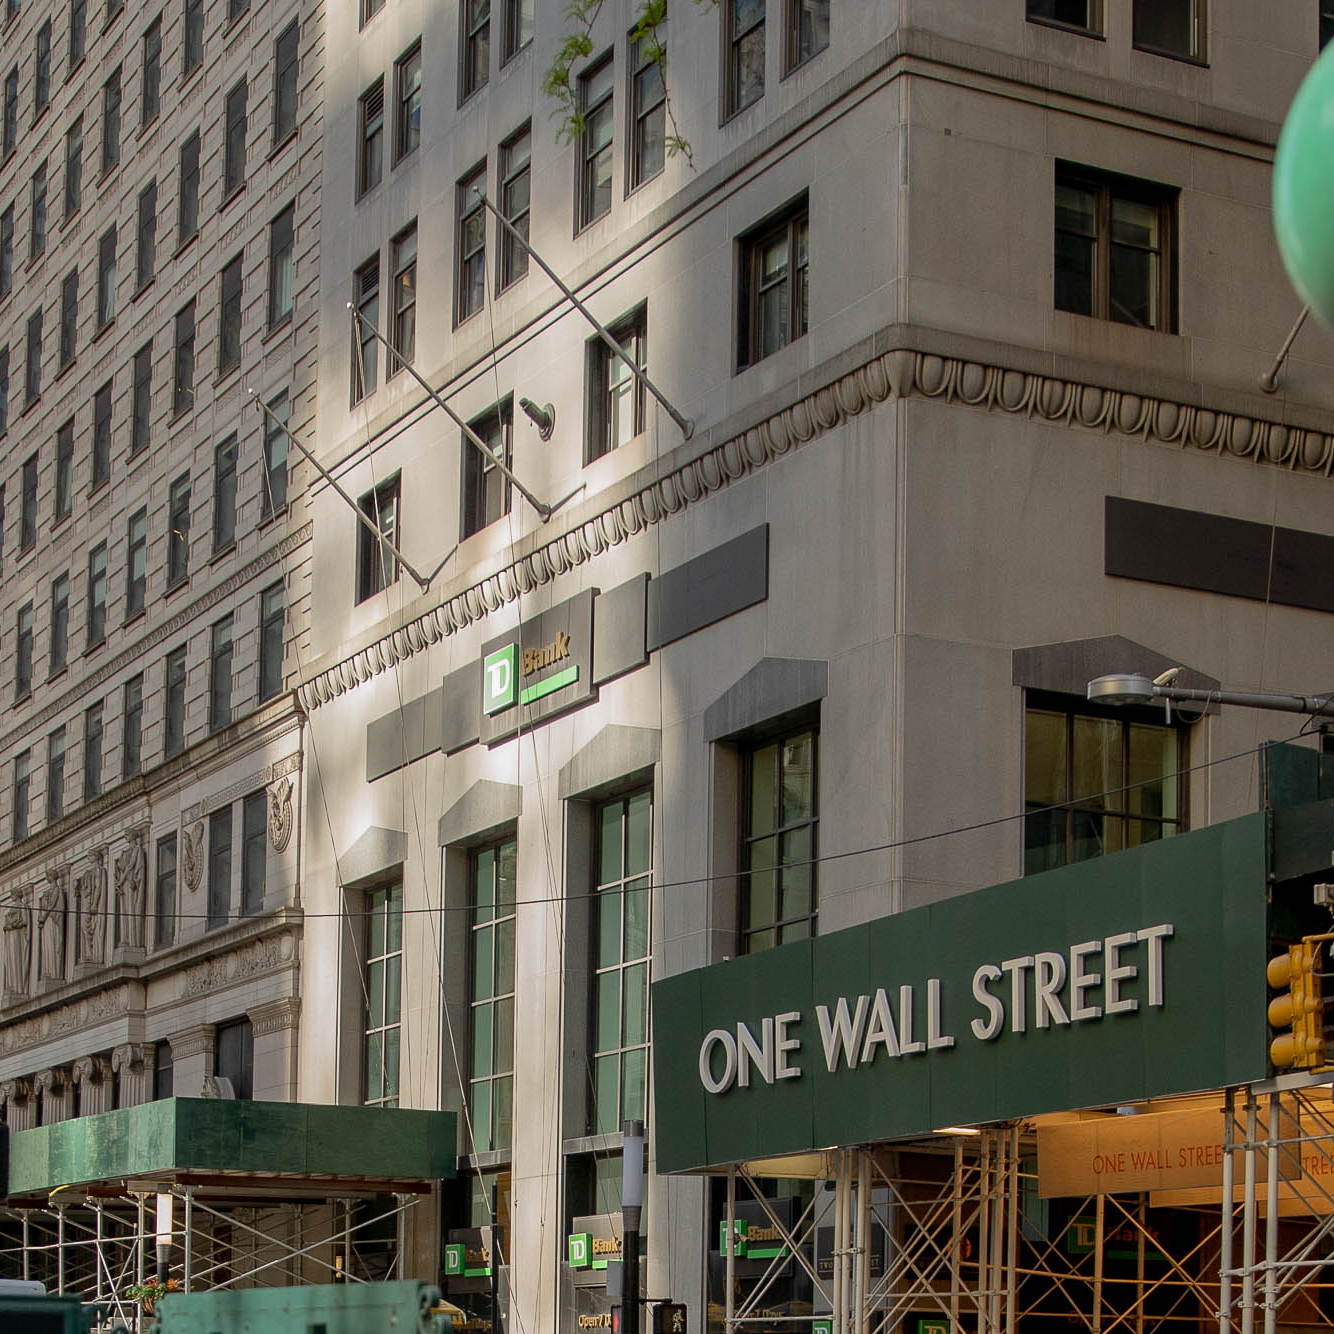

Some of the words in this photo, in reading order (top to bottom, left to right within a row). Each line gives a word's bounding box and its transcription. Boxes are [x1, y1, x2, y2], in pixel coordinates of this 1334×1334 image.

[488, 658, 510, 699] TD
[523, 632, 571, 677] Bank
[699, 1011, 801, 1094] ONE
[815, 978, 955, 1073] WALL
[970, 924, 1174, 1041] STREET
[1092, 1152, 1125, 1175] ONE
[1131, 1149, 1173, 1171] WALL
[1178, 1144, 1224, 1168] STREE
[447, 1249, 459, 1268] TD
[571, 1239, 585, 1260] TD
[592, 1235, 621, 1254] Bank
